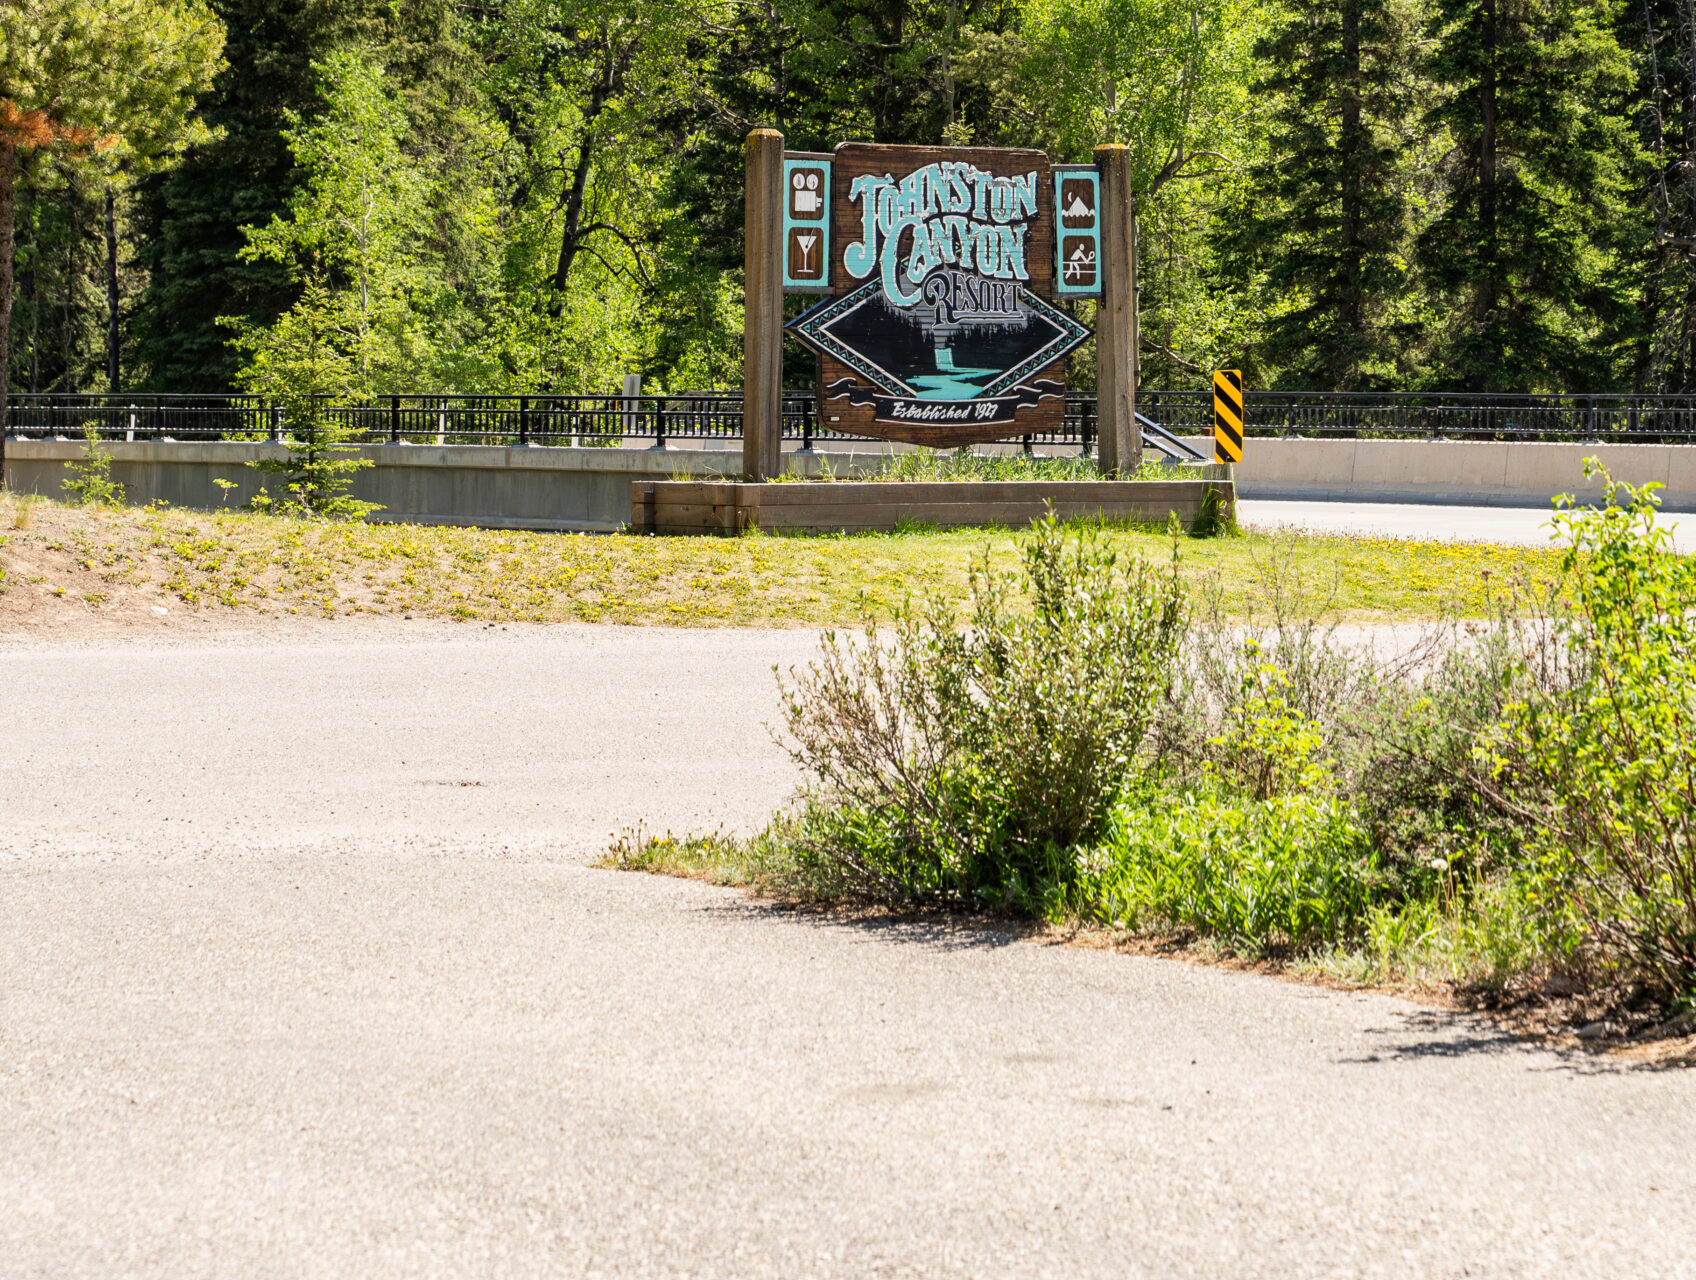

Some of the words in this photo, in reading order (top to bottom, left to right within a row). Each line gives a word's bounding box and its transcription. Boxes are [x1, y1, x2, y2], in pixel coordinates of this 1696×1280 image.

[843, 161, 1039, 279] JOHNSTON
[880, 215, 1029, 307] CANYON
[921, 271, 1023, 326] RESORT
[891, 401, 971, 420] Established
[974, 402, 998, 419] 1927
